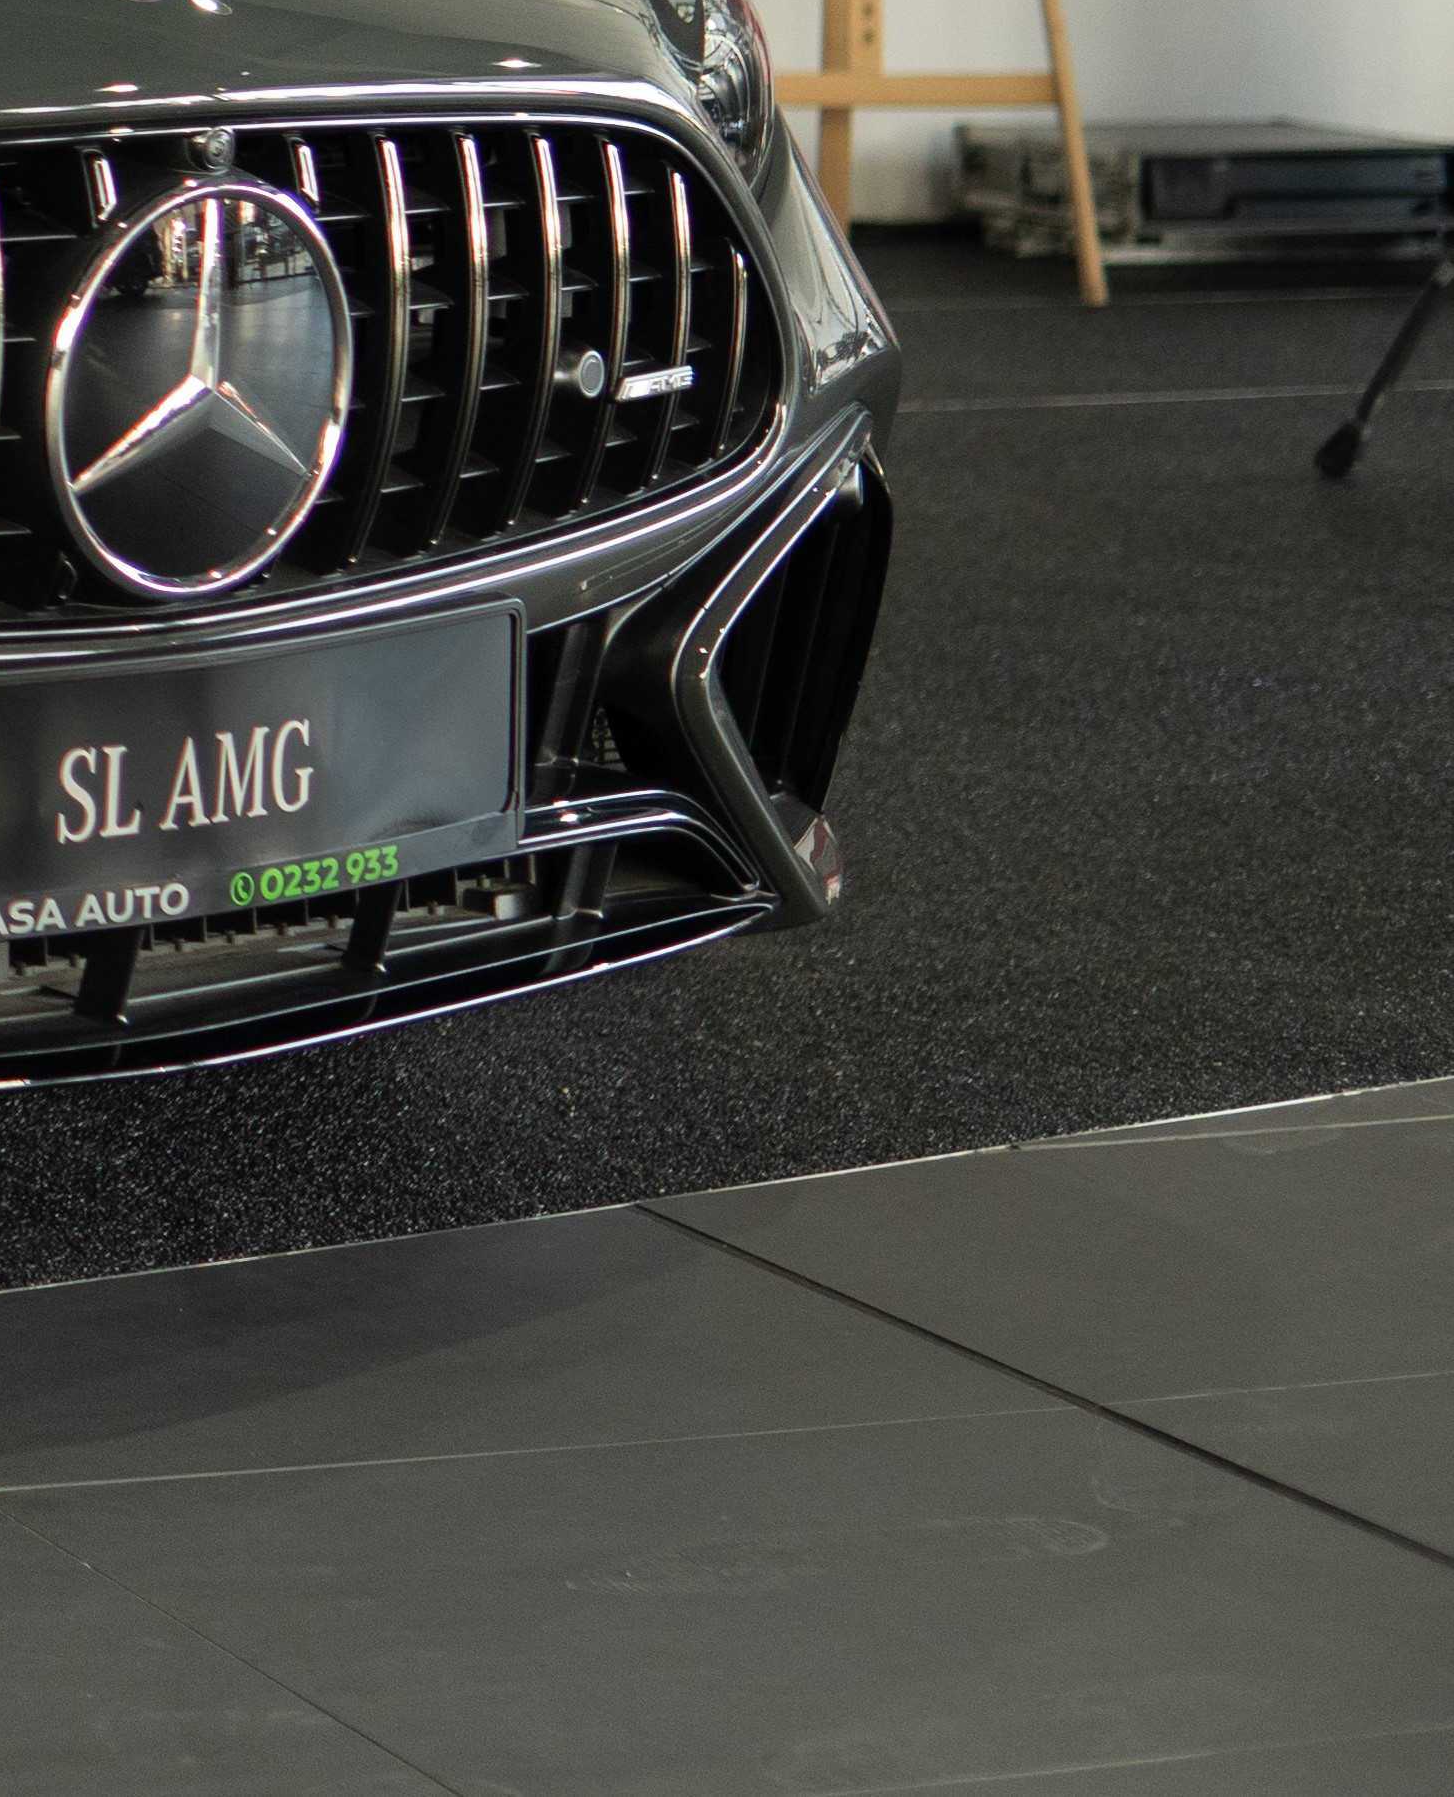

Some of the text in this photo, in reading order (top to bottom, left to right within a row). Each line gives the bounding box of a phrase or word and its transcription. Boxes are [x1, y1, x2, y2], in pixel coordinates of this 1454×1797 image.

[56, 717, 314, 844] SL AMG
[259, 845, 399, 900] 0232 933
[74, 882, 190, 928] AUTO
